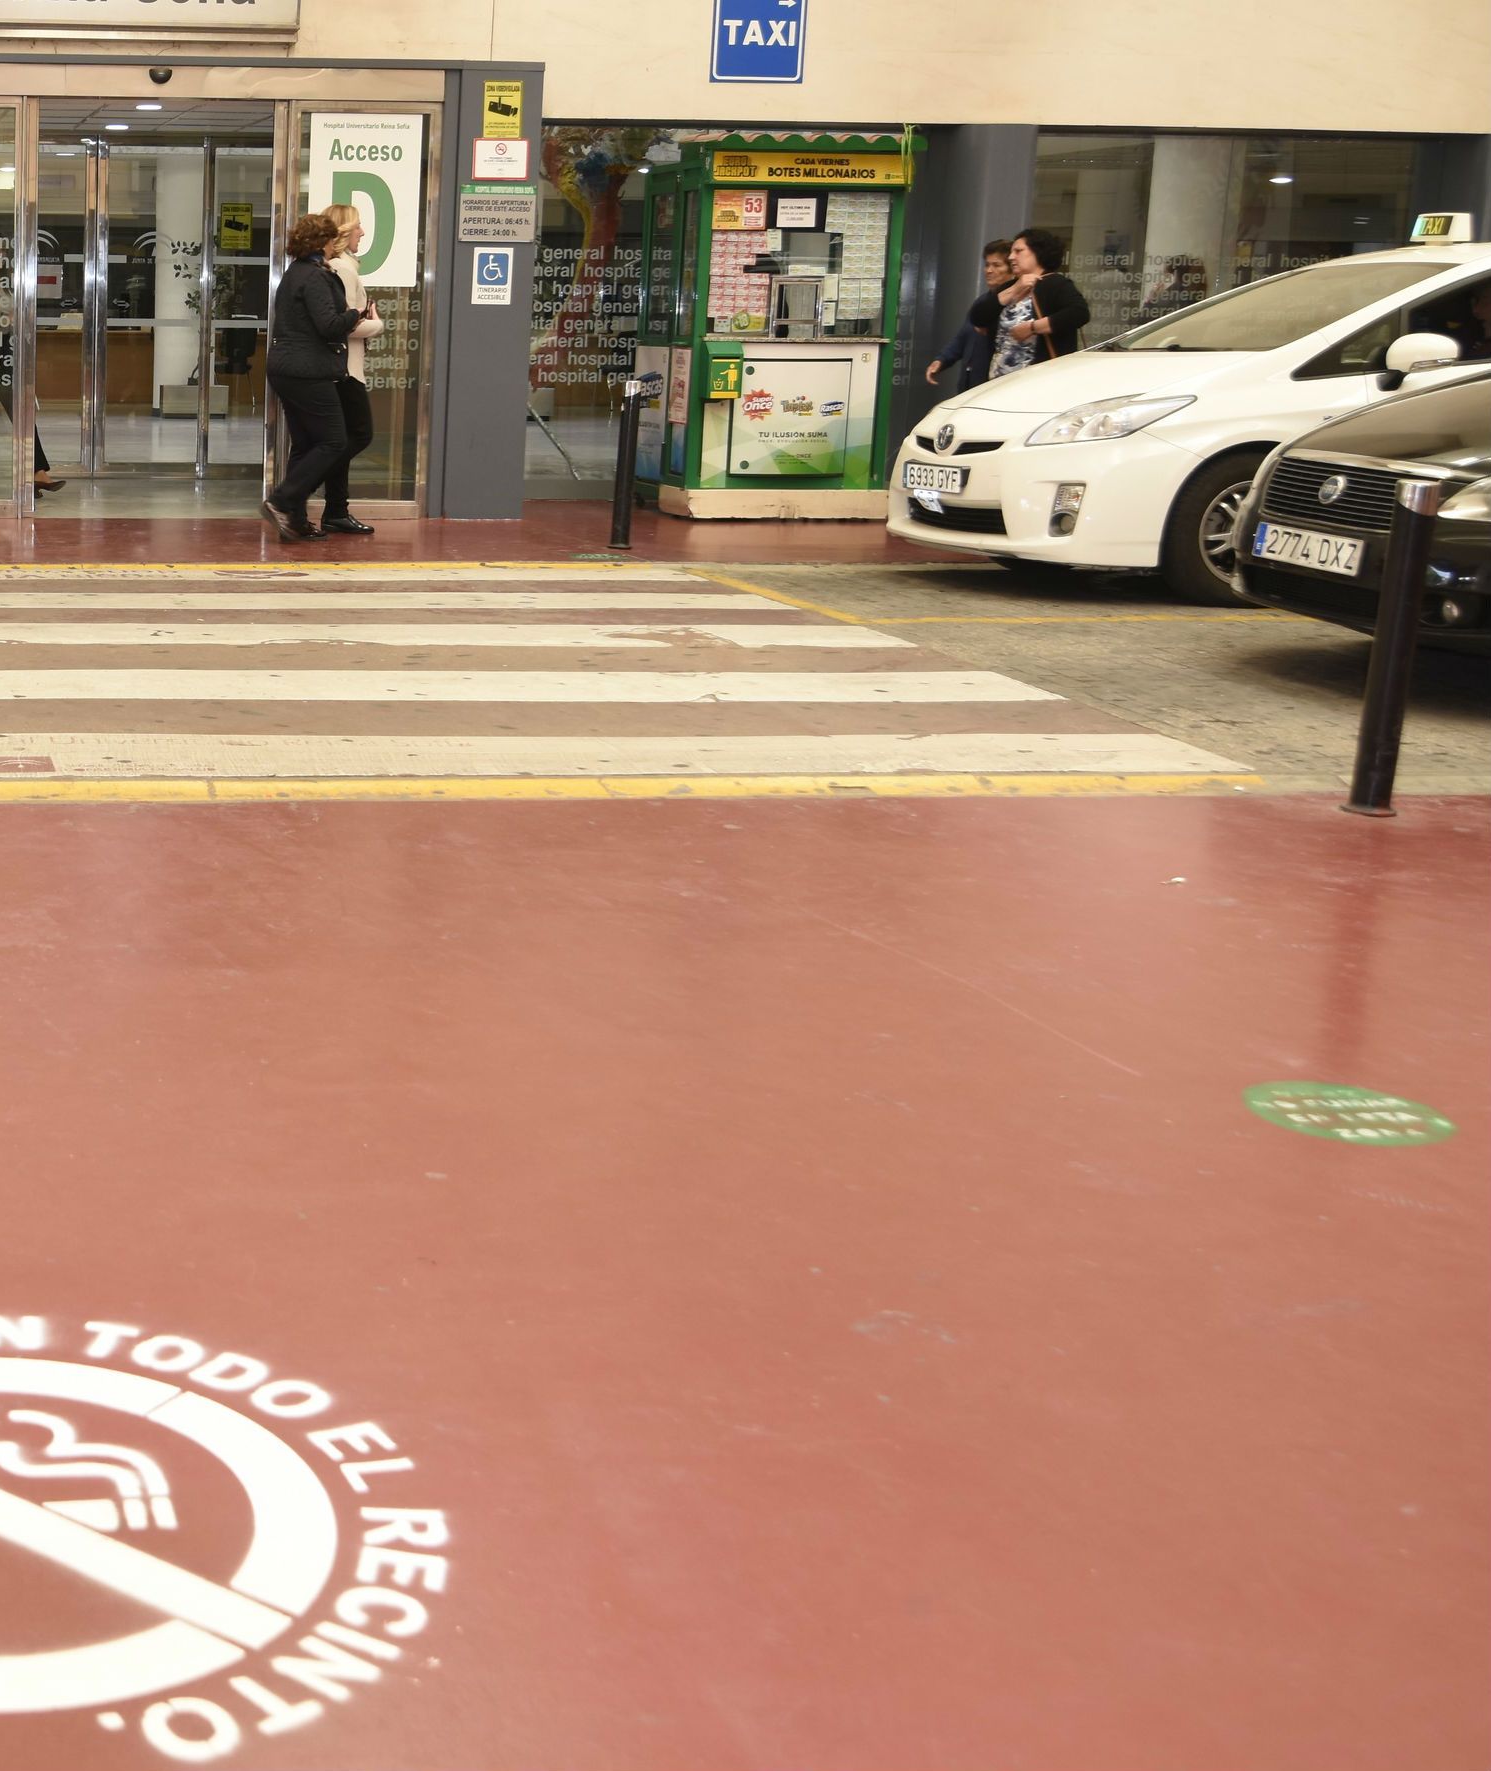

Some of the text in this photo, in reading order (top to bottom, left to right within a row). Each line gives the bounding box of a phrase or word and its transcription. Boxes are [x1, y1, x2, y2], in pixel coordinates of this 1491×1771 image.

[722, 19, 797, 46] TAXI
[323, 122, 345, 131] Hospital
[329, 139, 403, 161] Acceso
[817, 158, 850, 166] VIERNES
[767, 167, 801, 178] BOTES
[803, 167, 875, 179] MILLONARIOS
[745, 197, 762, 213] 53
[332, 171, 396, 276] D
[462, 217, 503, 225] APERTURA:
[1420, 217, 1445, 234] TAXI
[462, 228, 490, 236] CIERRE:
[543, 246, 604, 262] general
[1075, 252, 1134, 268] general
[553, 281, 617, 299] hospital
[568, 352, 632, 369] hospital
[538, 369, 602, 387] hospital
[909, 467, 958, 490] 6933 GYF
[1266, 529, 1357, 570] 2774 DXZ
[82, 1319, 333, 1420] TODO
[305, 1421, 417, 1494] EL
[95, 1503, 453, 1763] RECINTO.
